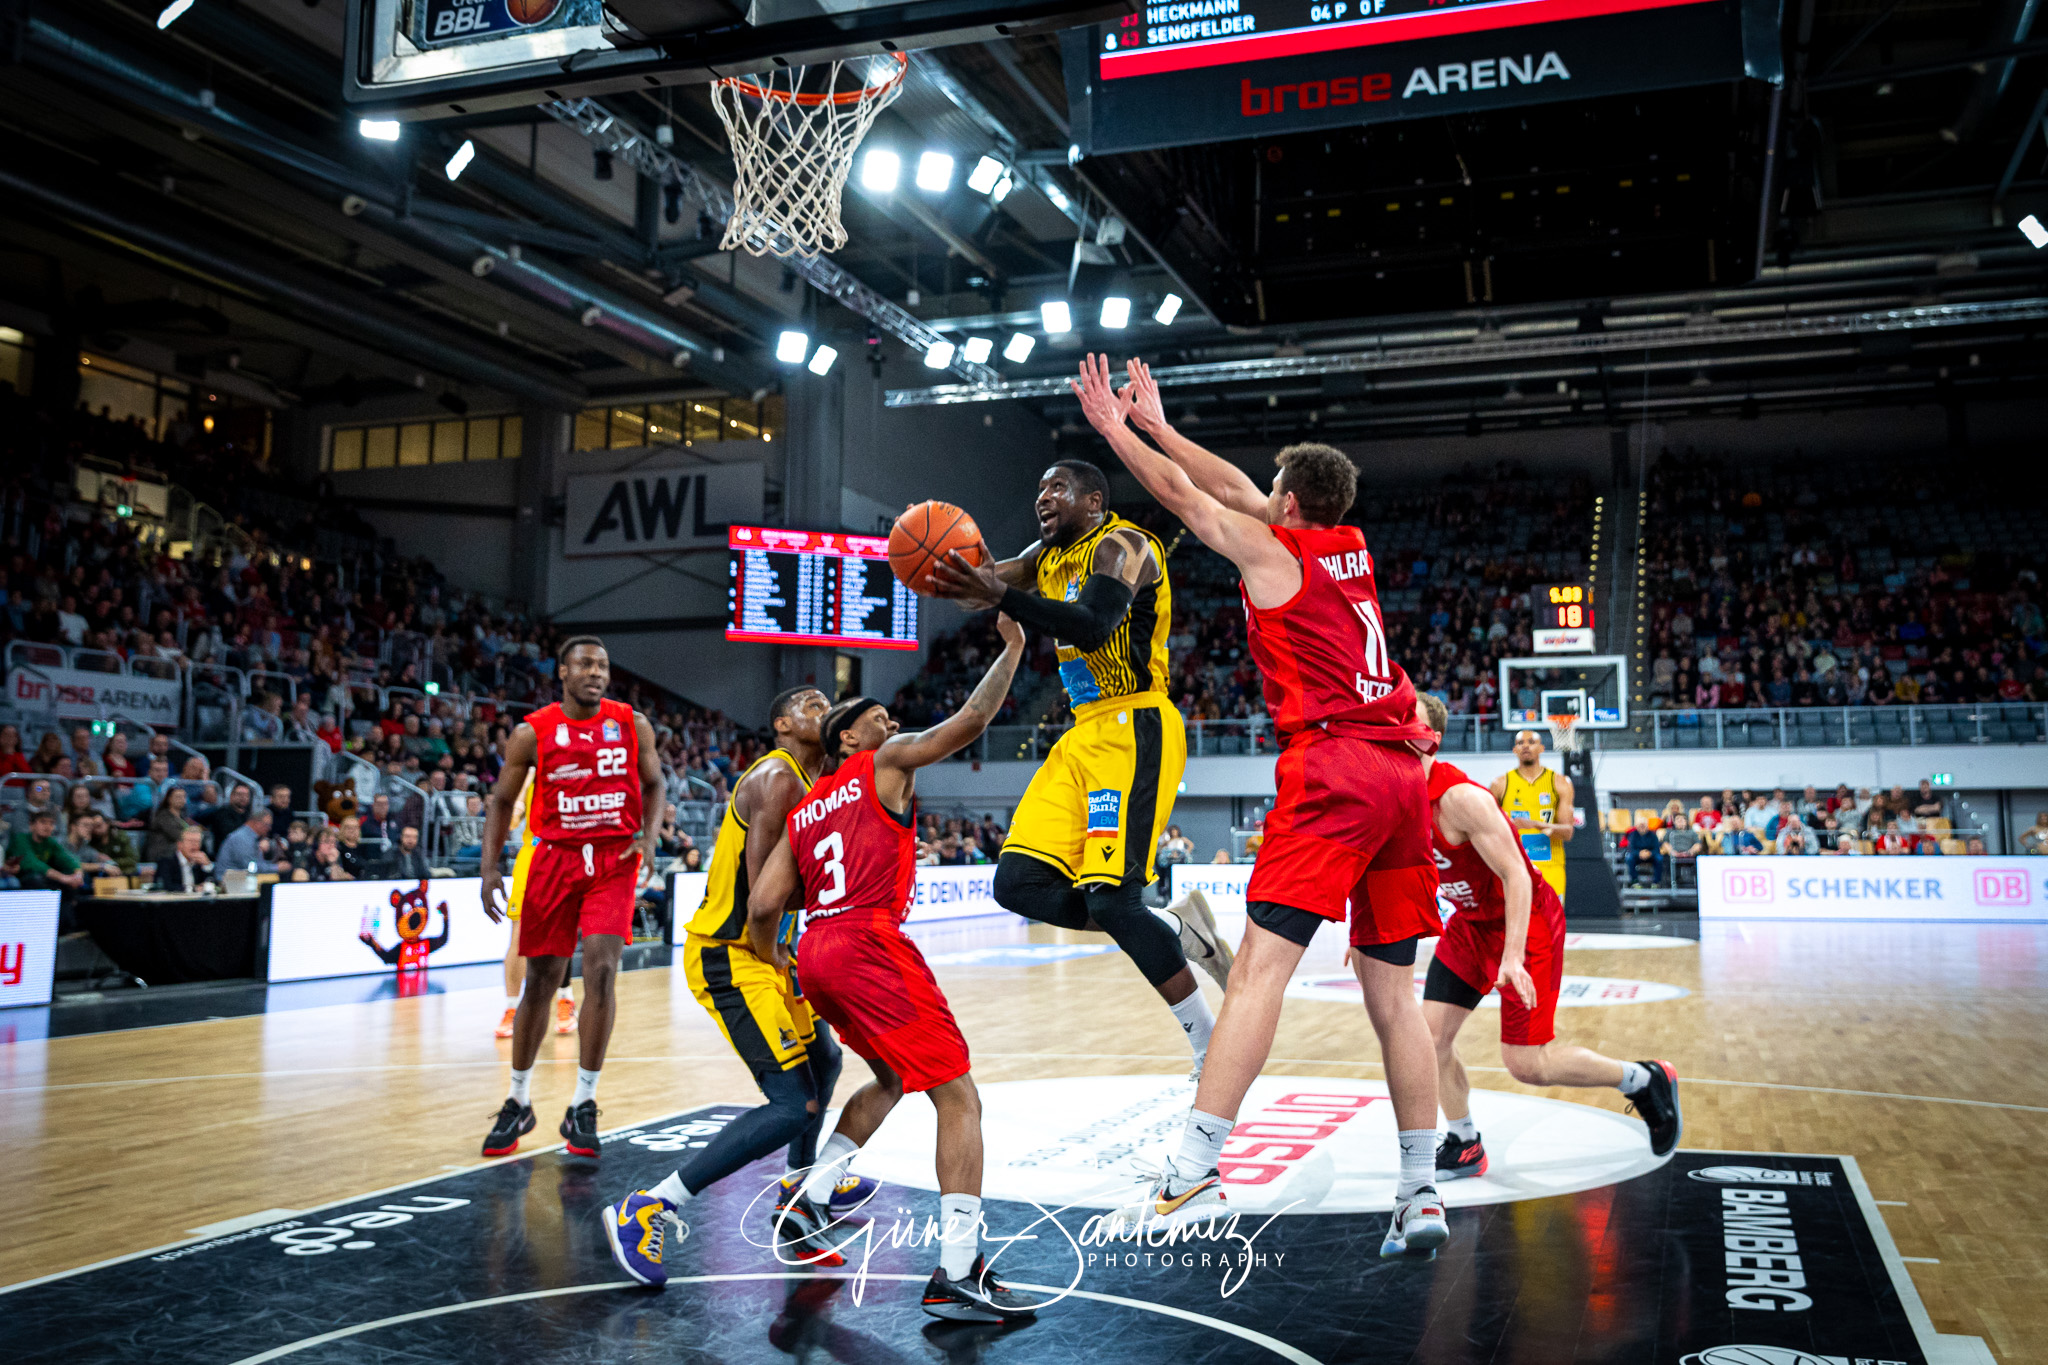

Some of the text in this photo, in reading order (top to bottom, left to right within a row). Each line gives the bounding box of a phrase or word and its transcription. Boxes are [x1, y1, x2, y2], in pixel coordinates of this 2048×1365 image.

[434, 5, 490, 37] BBL
[1146, 0, 1239, 24] HECKMANN
[1335, 1, 1347, 19] P
[1147, 14, 1255, 44] SENGFELDER
[1241, 50, 1571, 117] brose ARENA
[583, 475, 730, 545] AWL
[1318, 549, 1371, 581] HLRA
[101, 687, 172, 711] ARENA
[596, 747, 627, 777] 22
[558, 791, 627, 813] brose
[793, 778, 862, 832] THOMAS
[813, 831, 846, 906] 3
[1730, 875, 1767, 898] DB
[1786, 877, 1944, 900] SCHENKER
[1982, 875, 2024, 899] DB
[1721, 1188, 1813, 1312] BAMBERG
